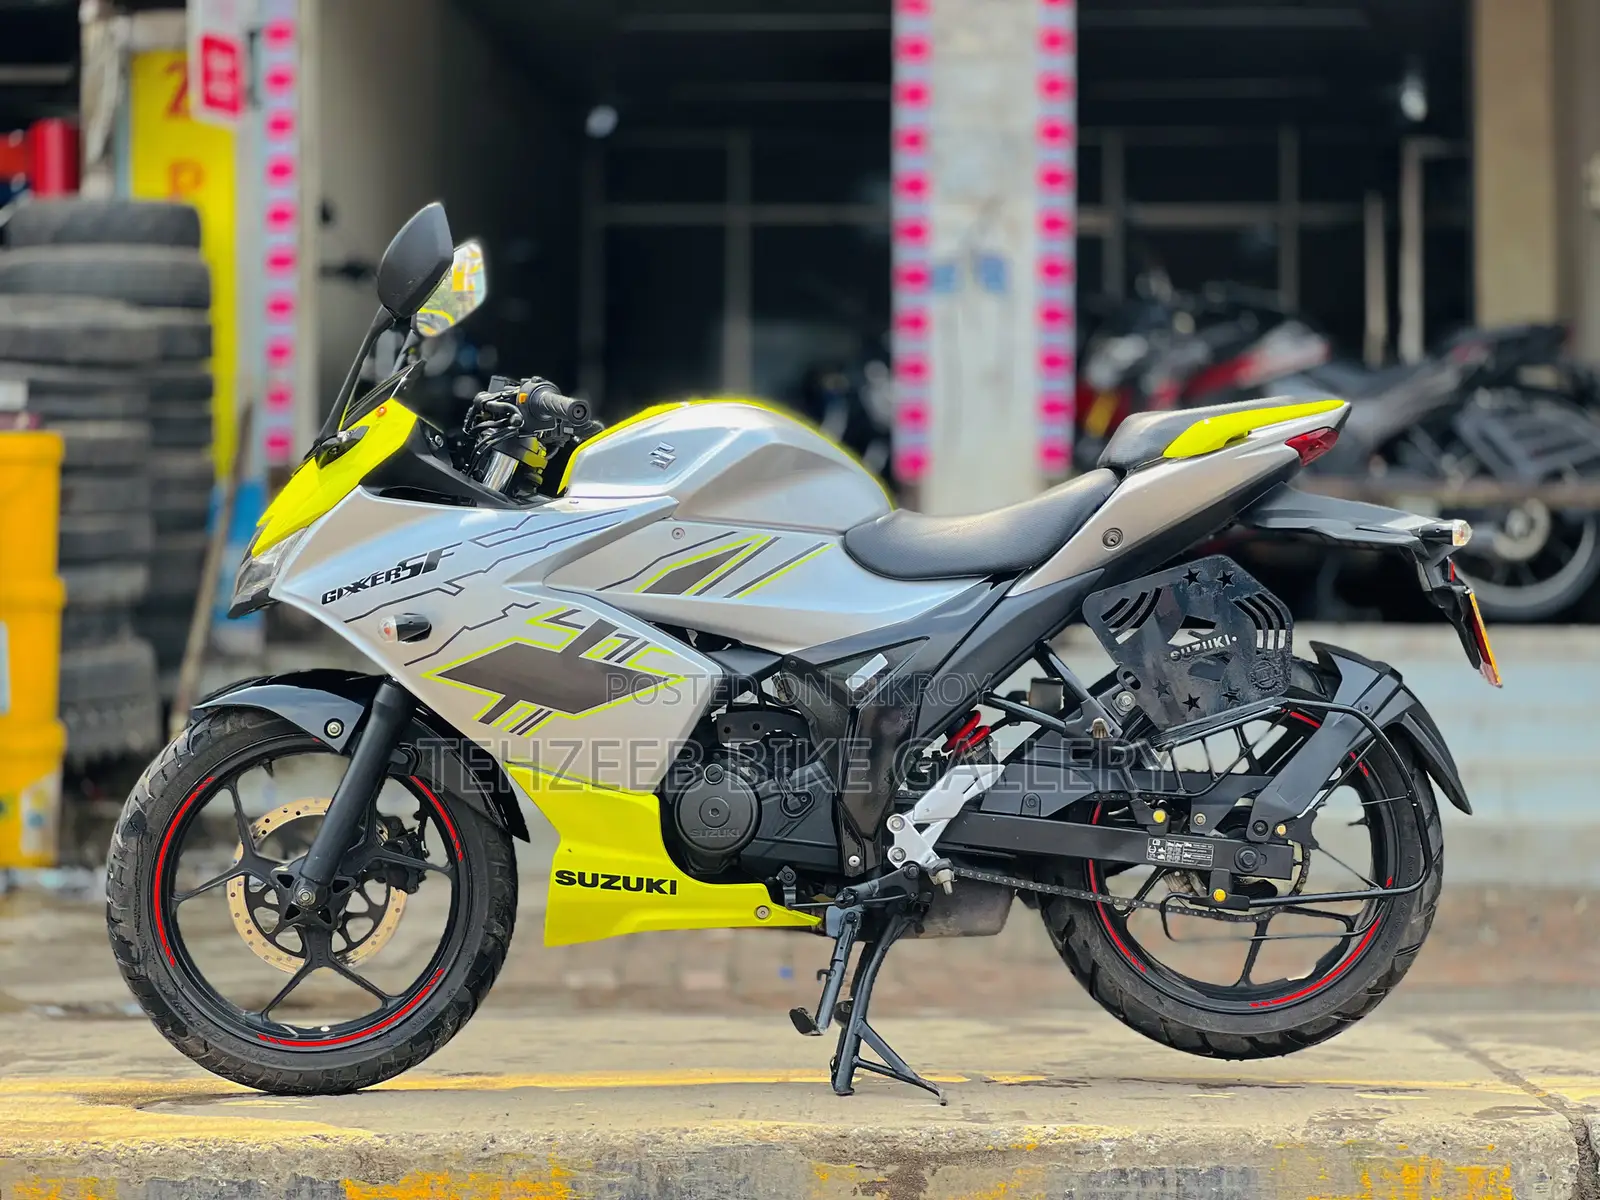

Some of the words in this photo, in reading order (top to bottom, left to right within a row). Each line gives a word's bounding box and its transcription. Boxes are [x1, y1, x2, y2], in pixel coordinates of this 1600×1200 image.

[321, 566, 402, 605] GIXXER
[391, 541, 463, 584] SF
[690, 829, 740, 838] SUZUKI
[555, 870, 677, 895] SUZUKI
